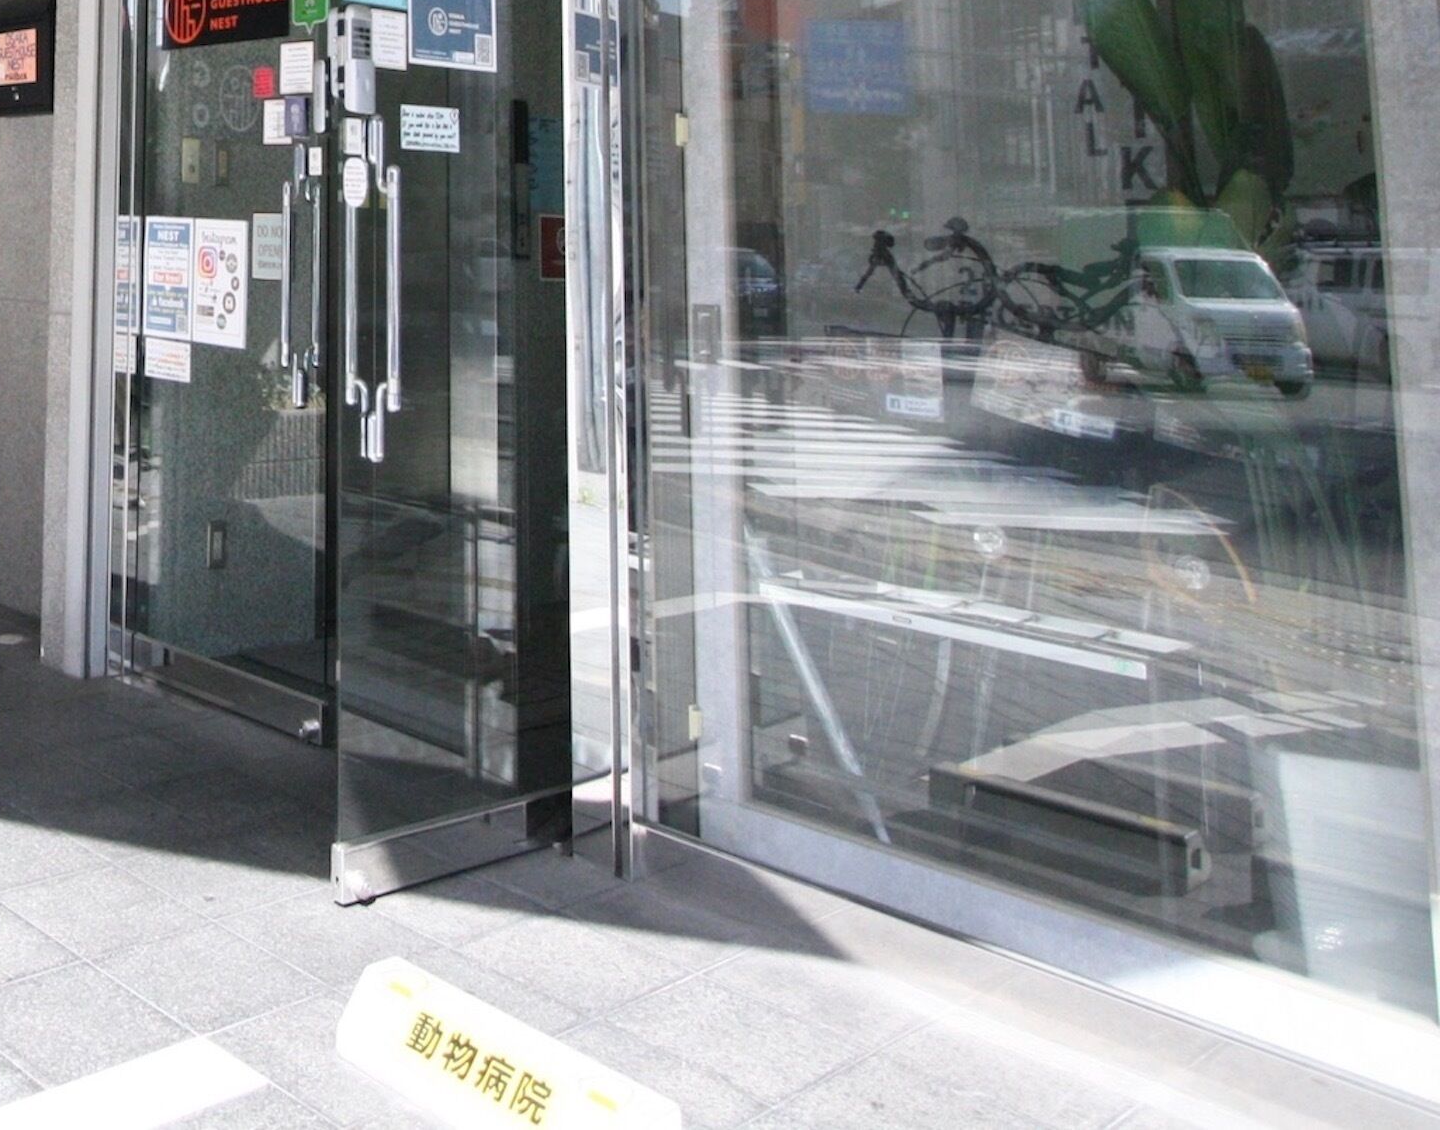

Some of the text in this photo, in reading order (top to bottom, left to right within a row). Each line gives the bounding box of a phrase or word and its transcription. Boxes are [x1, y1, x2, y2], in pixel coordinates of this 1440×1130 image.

[210, 15, 239, 31] NEST
[156, 230, 180, 242] NEST
[201, 230, 238, 246] Instagram
[405, 1011, 553, 1126] 動物病院
